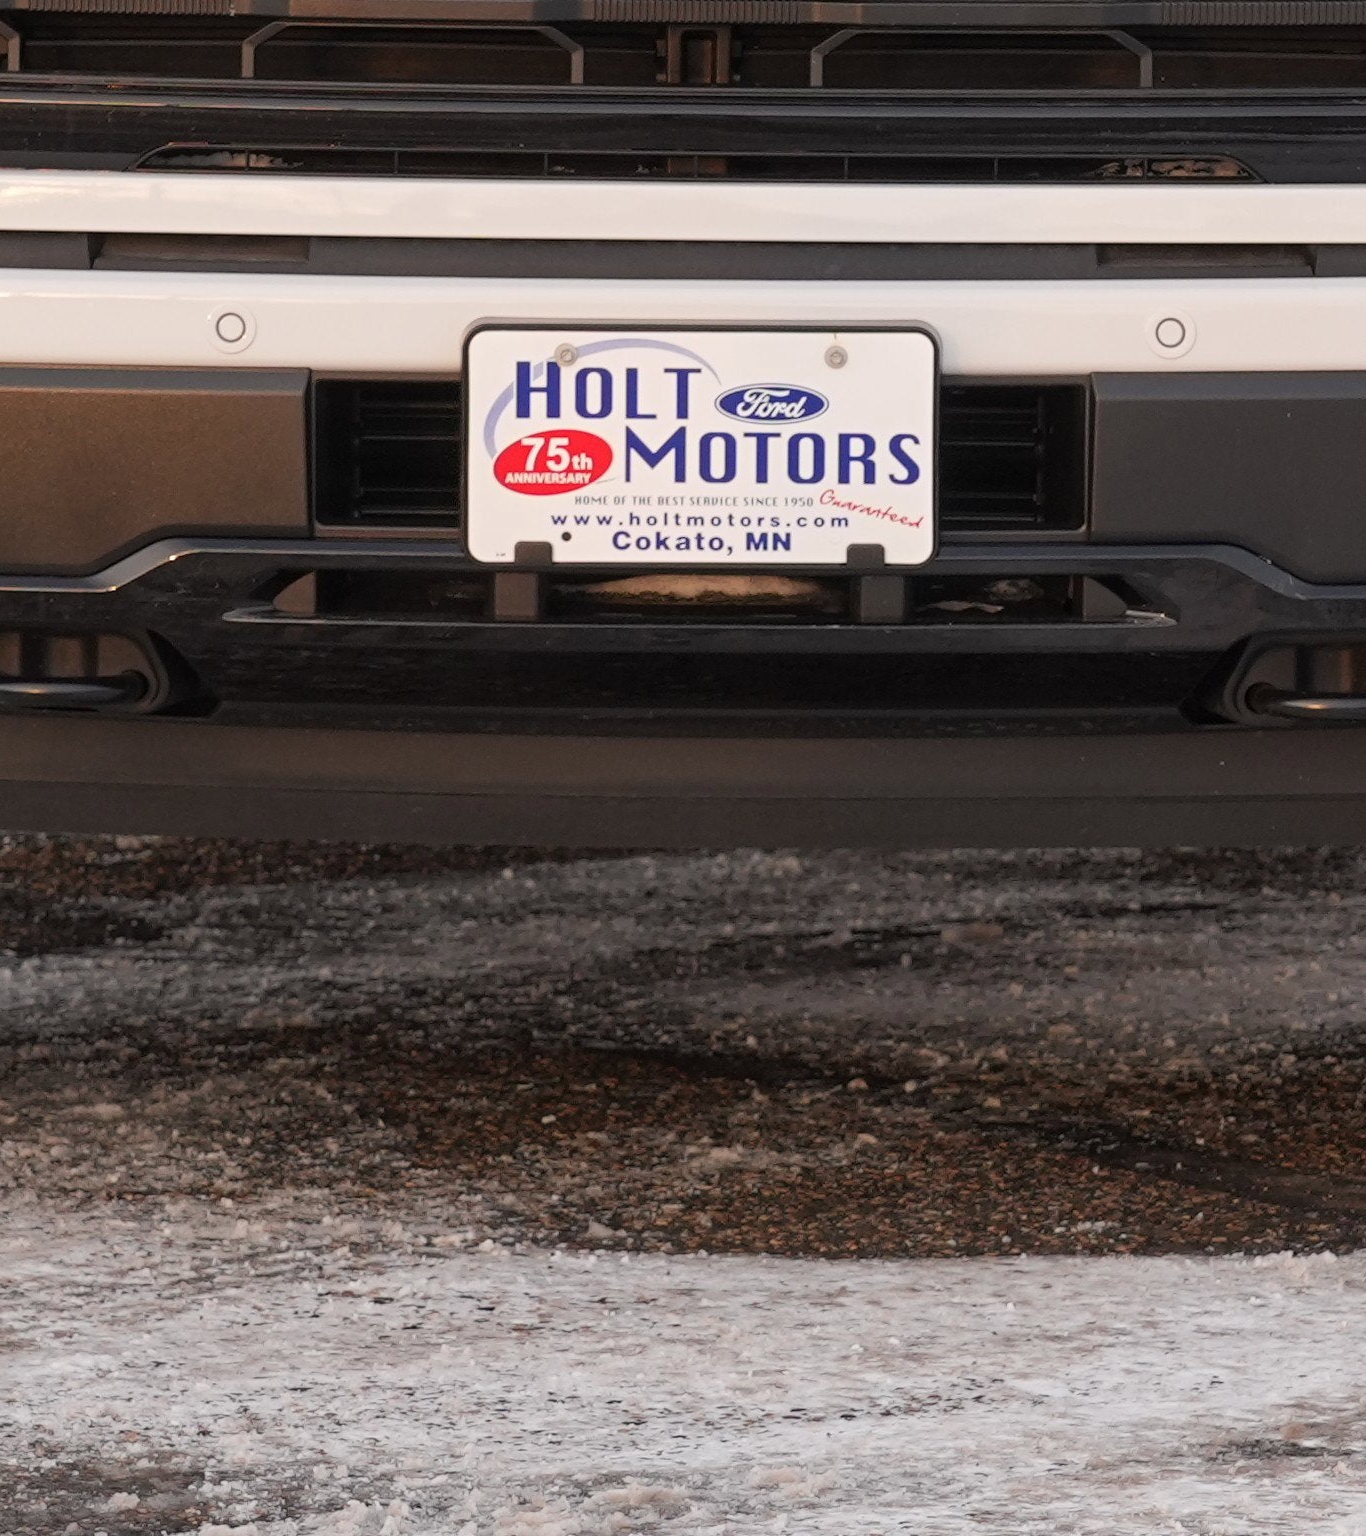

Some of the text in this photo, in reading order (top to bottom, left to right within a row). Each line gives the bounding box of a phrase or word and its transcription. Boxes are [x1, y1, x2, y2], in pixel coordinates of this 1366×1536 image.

[516, 361, 702, 420] HOLT
[736, 387, 808, 419] Ford
[520, 437, 594, 472] 75th
[625, 426, 921, 485] MOTORS
[504, 472, 592, 485] ANNIVERSARY
[574, 495, 814, 507] HOME OF THE BEST SERVICE SINCE 1950
[819, 488, 924, 529] Guaranteed
[551, 513, 850, 528] www.holtmotors.com
[612, 530, 792, 556] Cokato, MN
